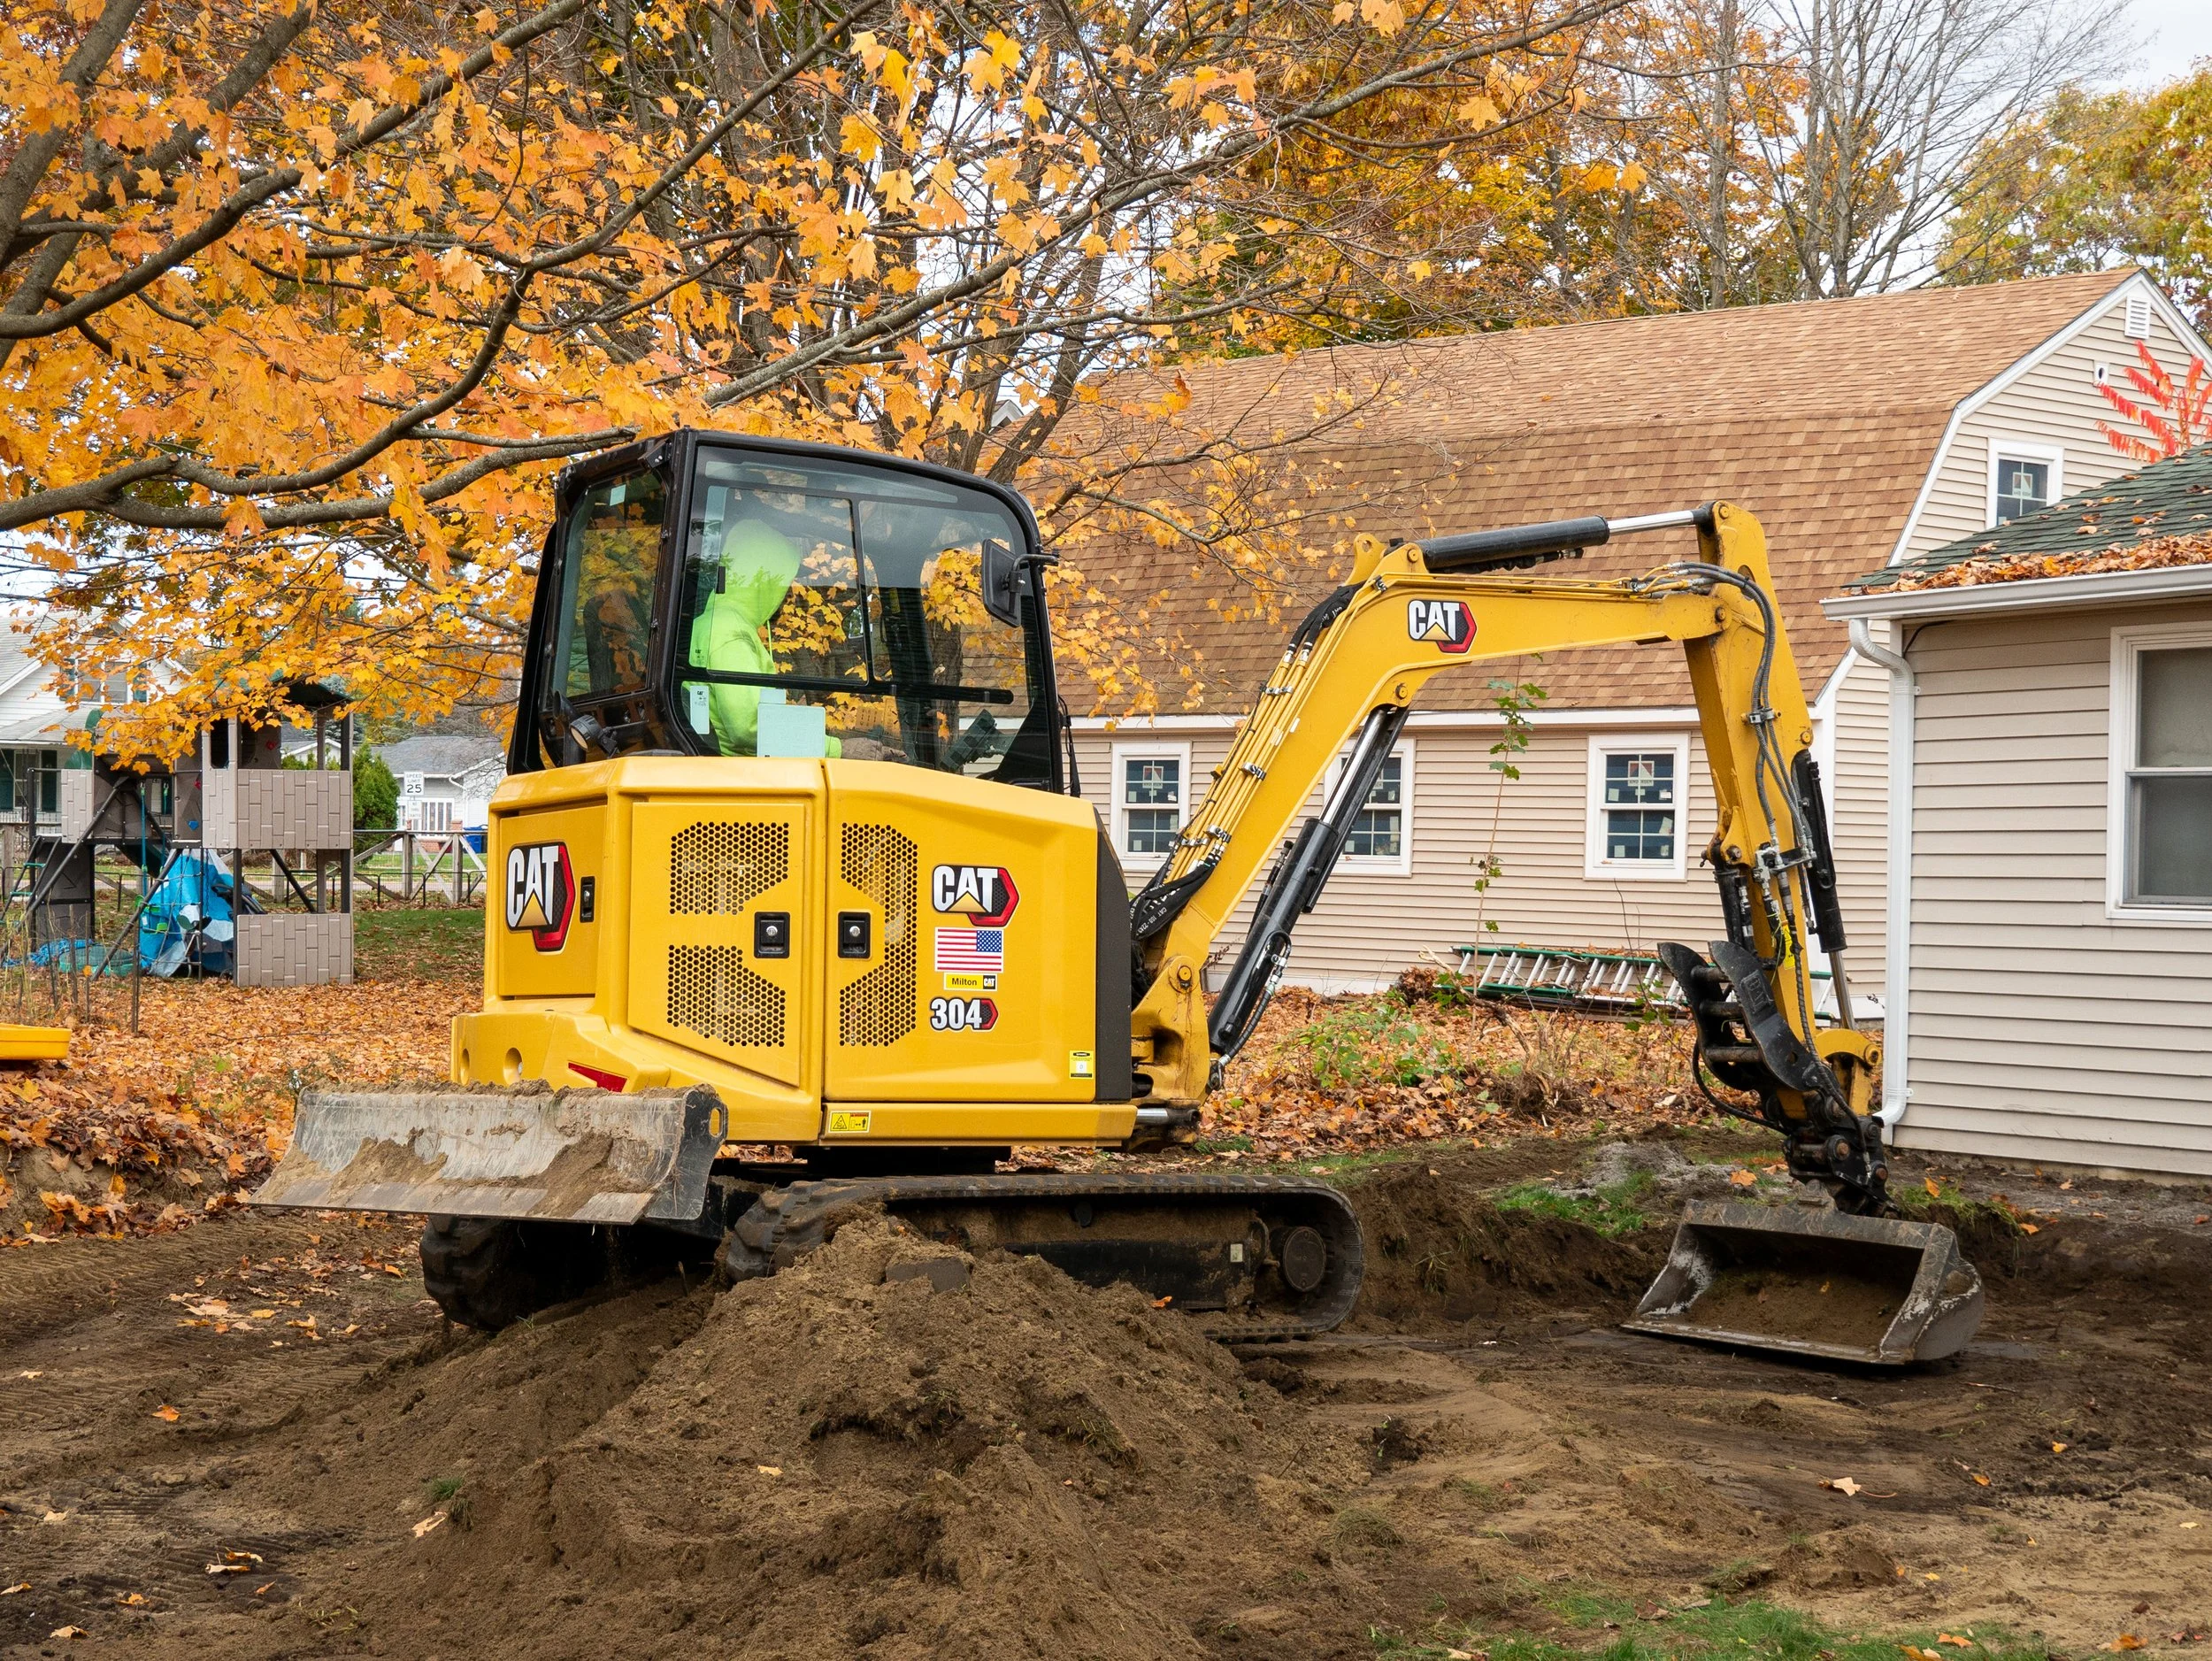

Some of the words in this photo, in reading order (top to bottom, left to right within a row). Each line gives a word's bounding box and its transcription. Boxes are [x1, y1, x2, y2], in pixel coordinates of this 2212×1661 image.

[1409, 600, 1460, 641] CAT
[407, 784, 422, 793] 25
[507, 845, 559, 927] CAT
[933, 865, 999, 913] CAT
[951, 977, 978, 986] Milton
[984, 978, 995, 987] CAT
[931, 998, 982, 1029] 304
